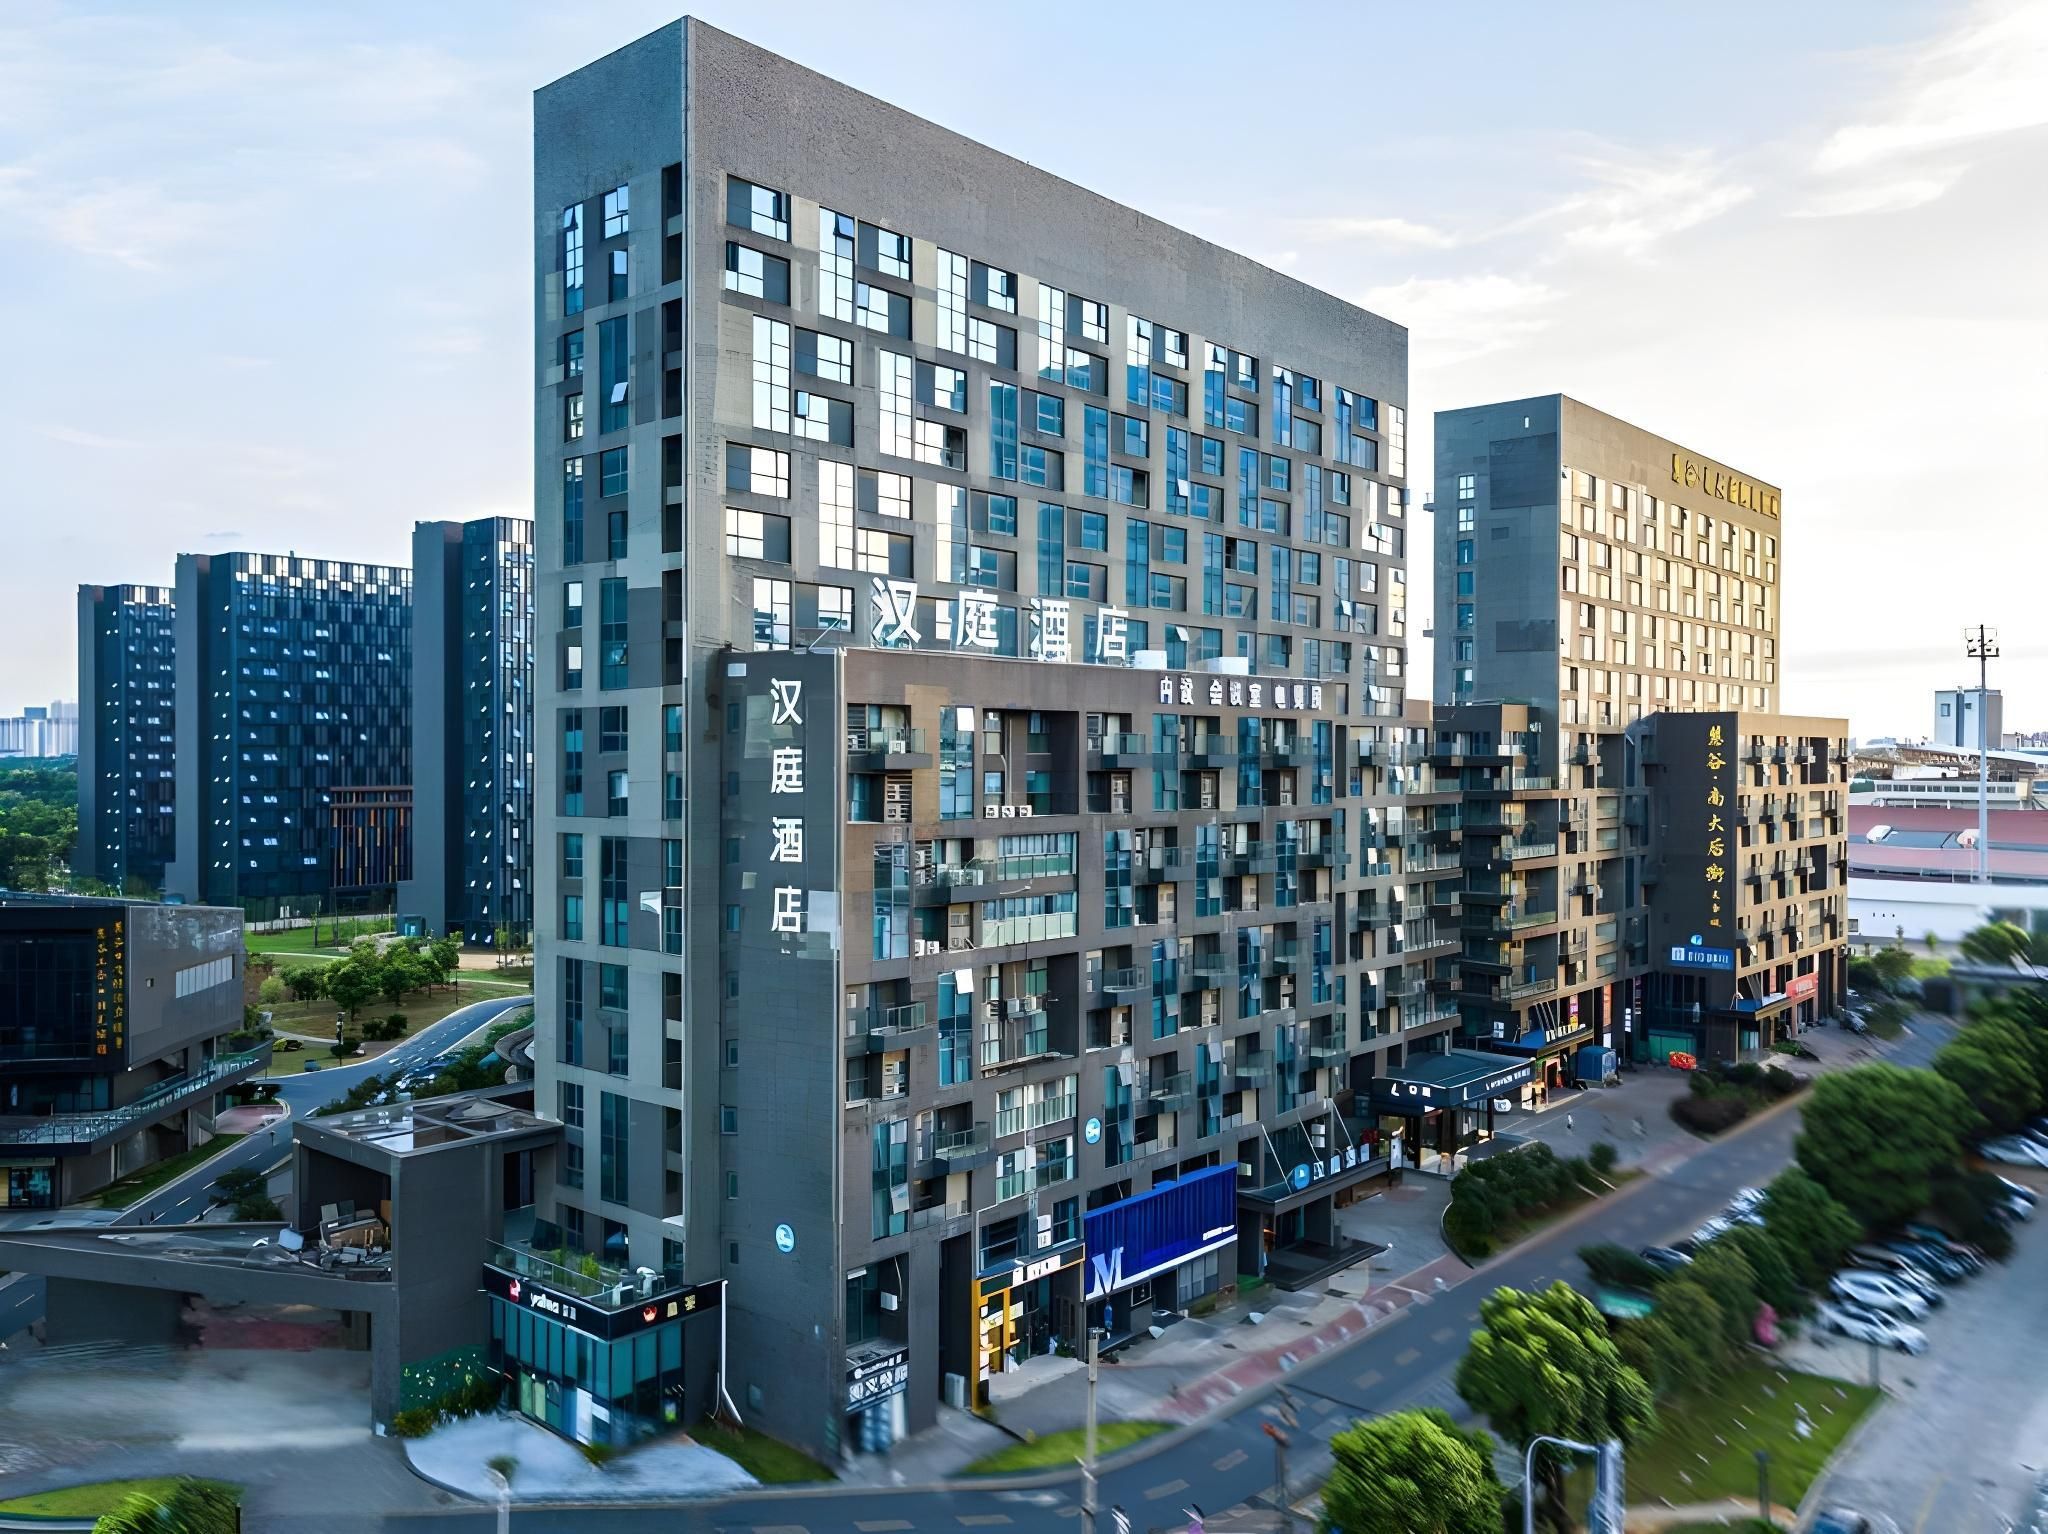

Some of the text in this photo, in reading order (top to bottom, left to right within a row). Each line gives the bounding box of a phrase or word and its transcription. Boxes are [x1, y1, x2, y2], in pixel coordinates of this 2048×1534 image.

[871, 577, 1129, 662] 汉庭酒店
[770, 678, 804, 933] 汉庭酒店
